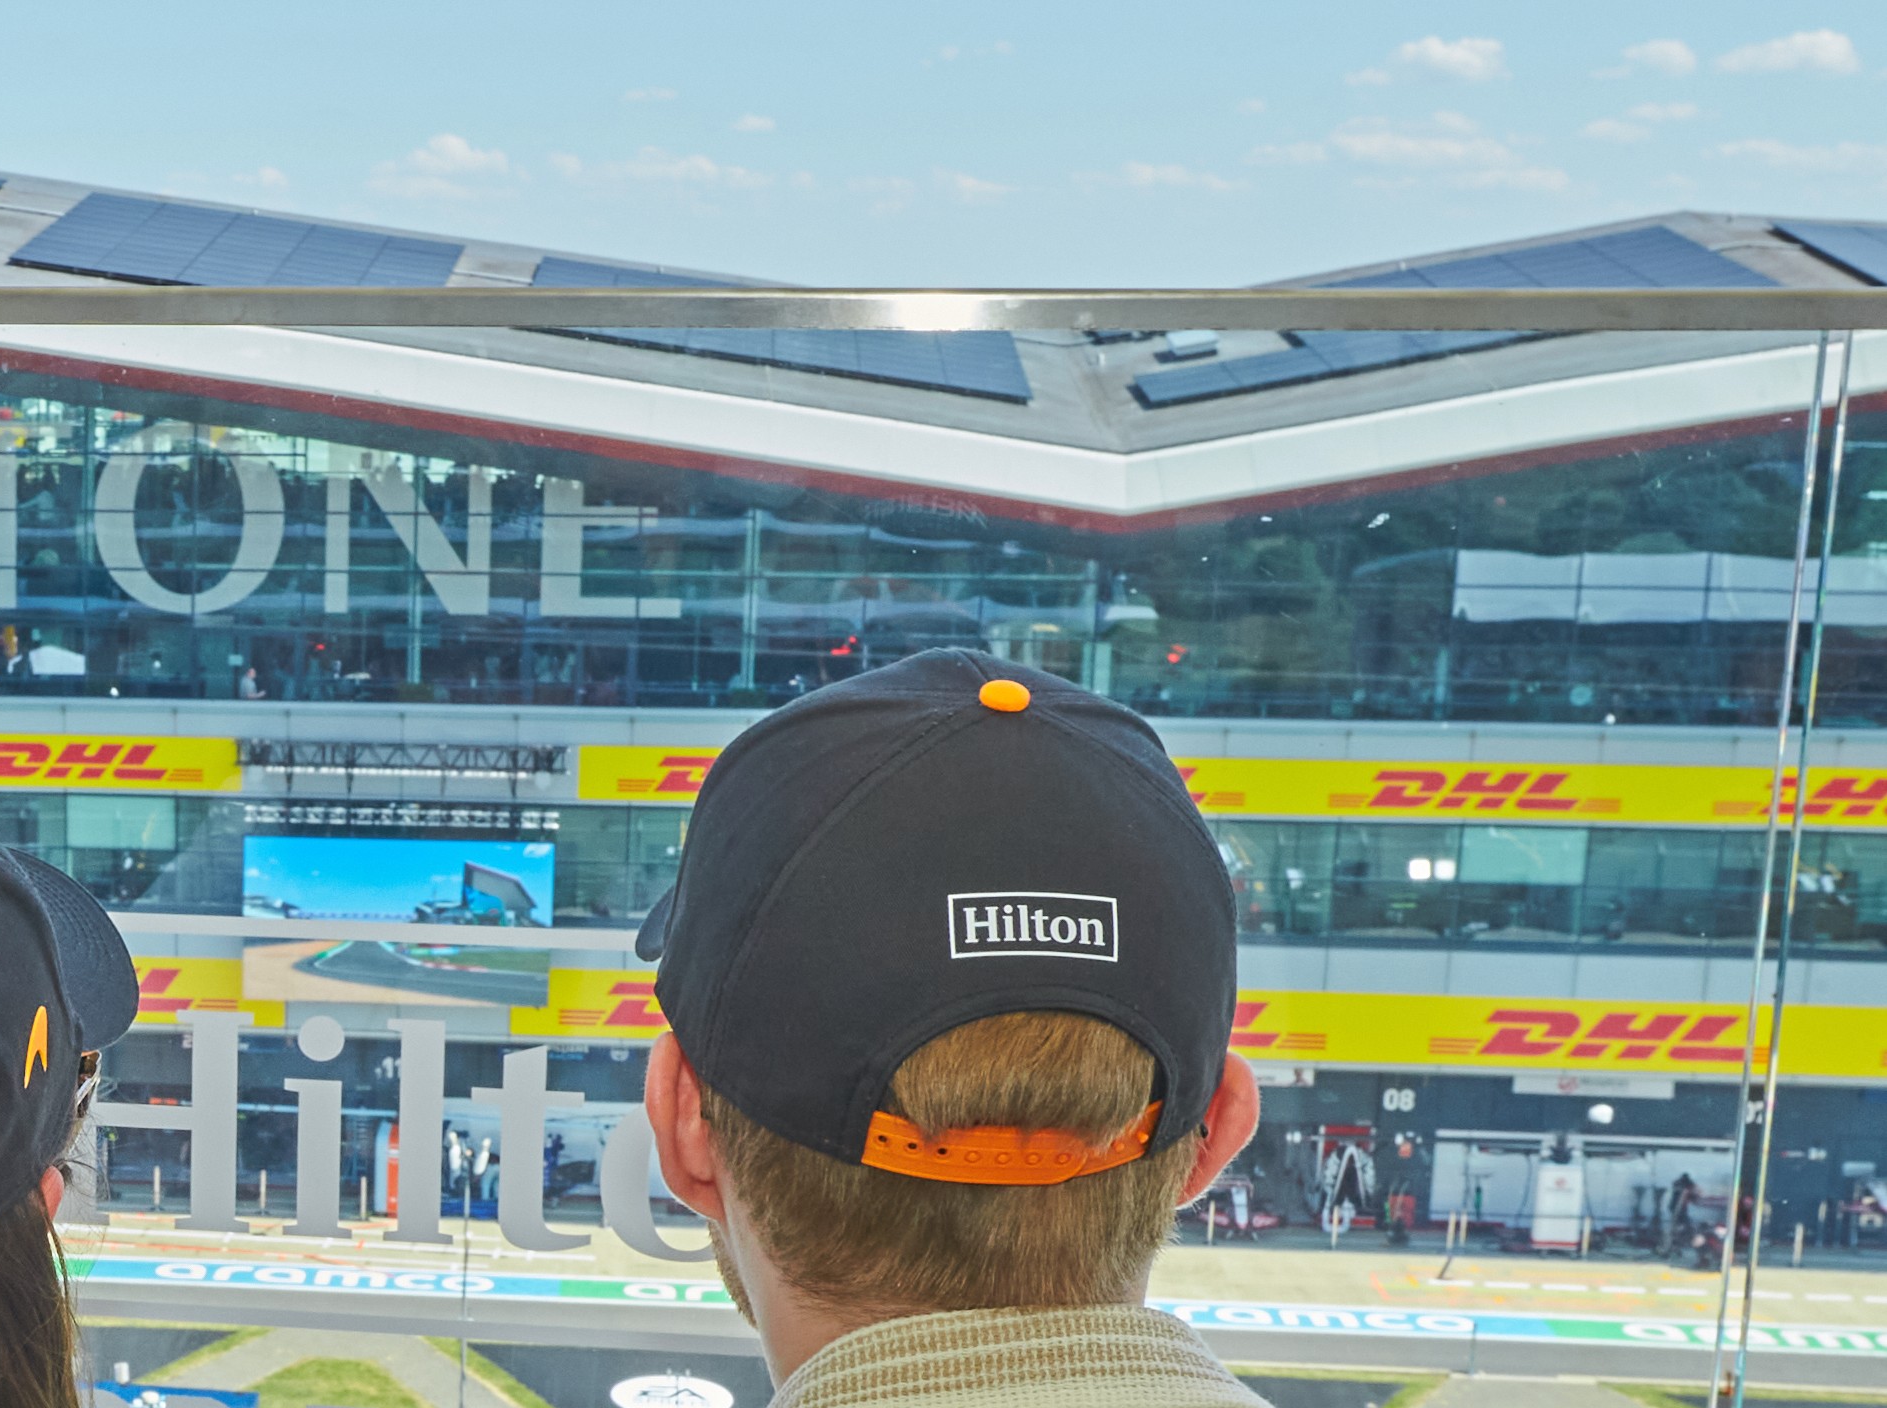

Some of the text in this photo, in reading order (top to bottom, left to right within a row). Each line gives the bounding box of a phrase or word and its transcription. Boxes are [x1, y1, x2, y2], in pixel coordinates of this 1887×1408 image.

[1367, 771, 1579, 811] DHL
[1758, 777, 1887, 816] DH
[963, 905, 1106, 946] Hilton
[1480, 1010, 1746, 1062] DHL
[1383, 1088, 1415, 1111] 08
[50, 1010, 716, 1263] Hilto
[154, 1263, 495, 1293] aramco
[1171, 1304, 1475, 1332] ramco
